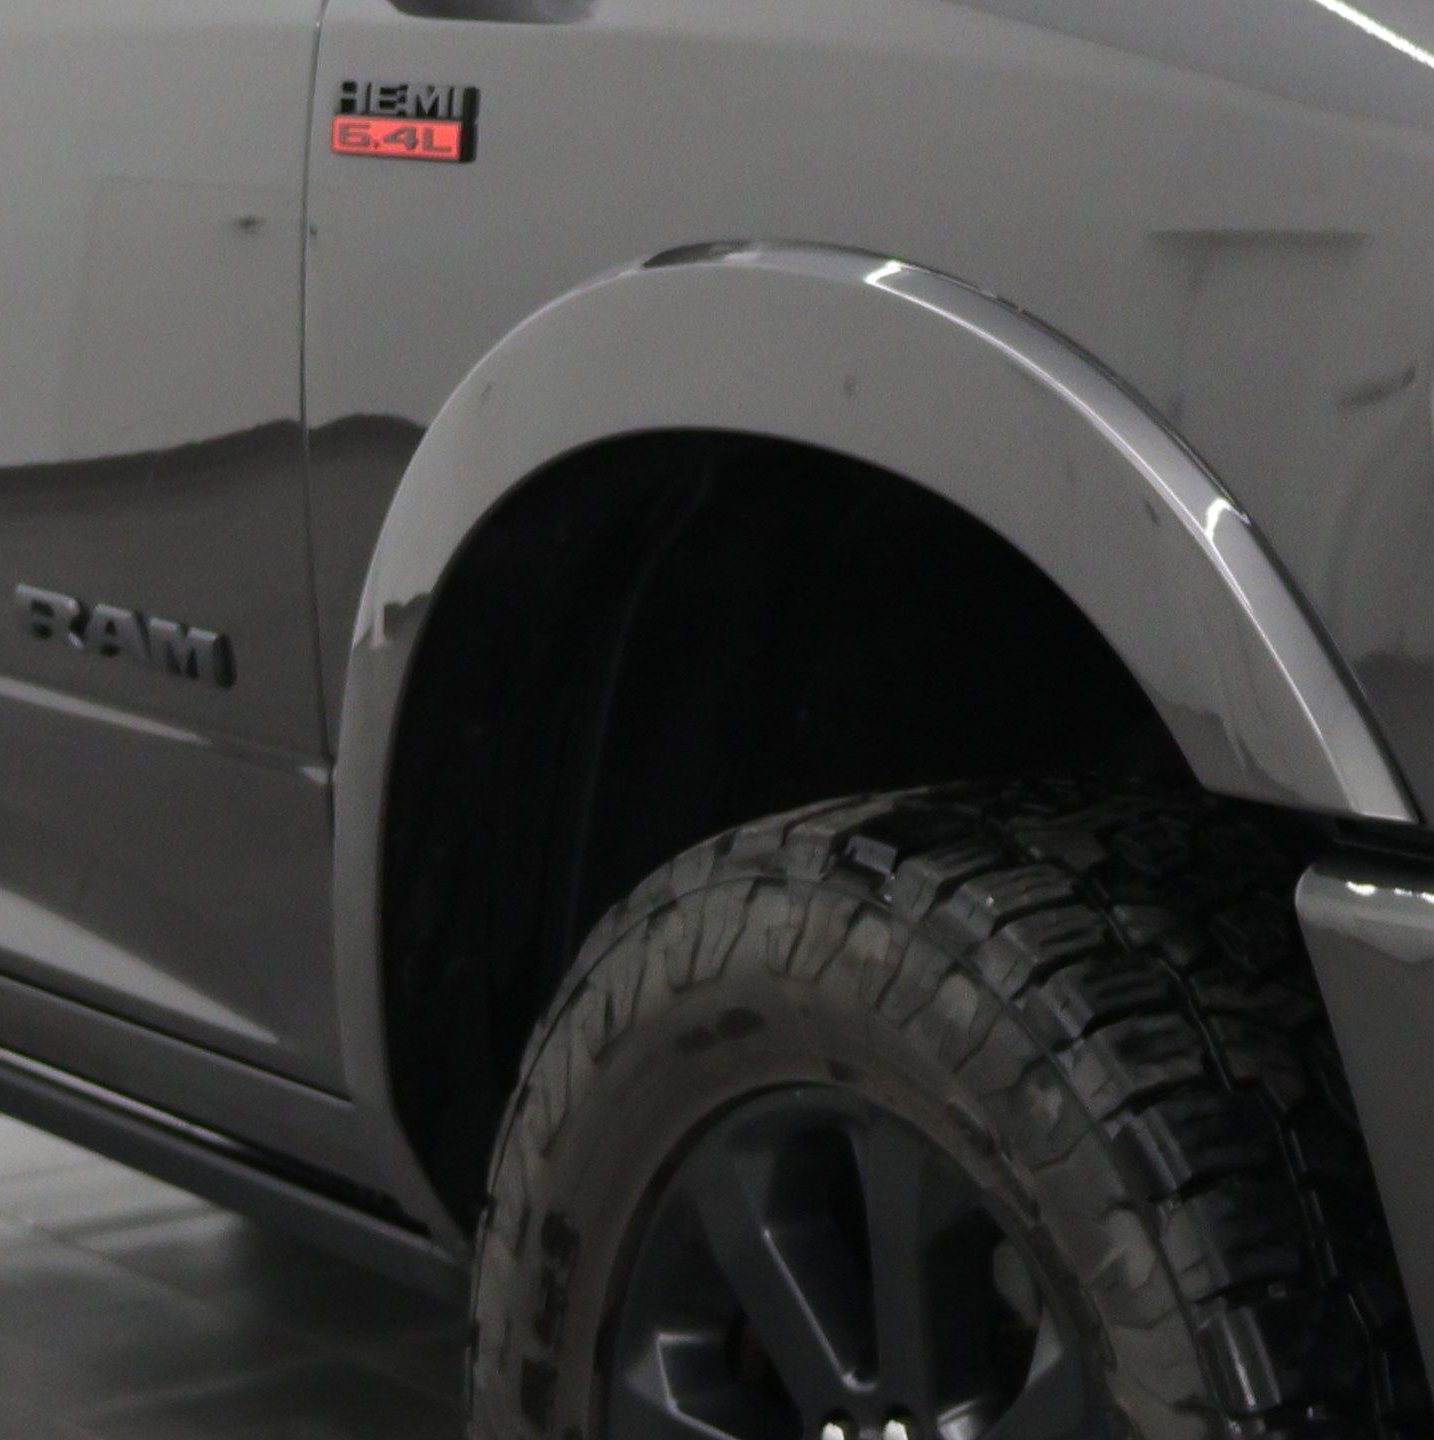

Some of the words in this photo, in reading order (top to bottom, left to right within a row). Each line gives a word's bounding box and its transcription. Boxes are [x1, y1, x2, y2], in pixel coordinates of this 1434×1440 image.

[335, 80, 468, 118] HEMI
[338, 122, 453, 153] 6.4L
[14, 582, 230, 687] RAM
